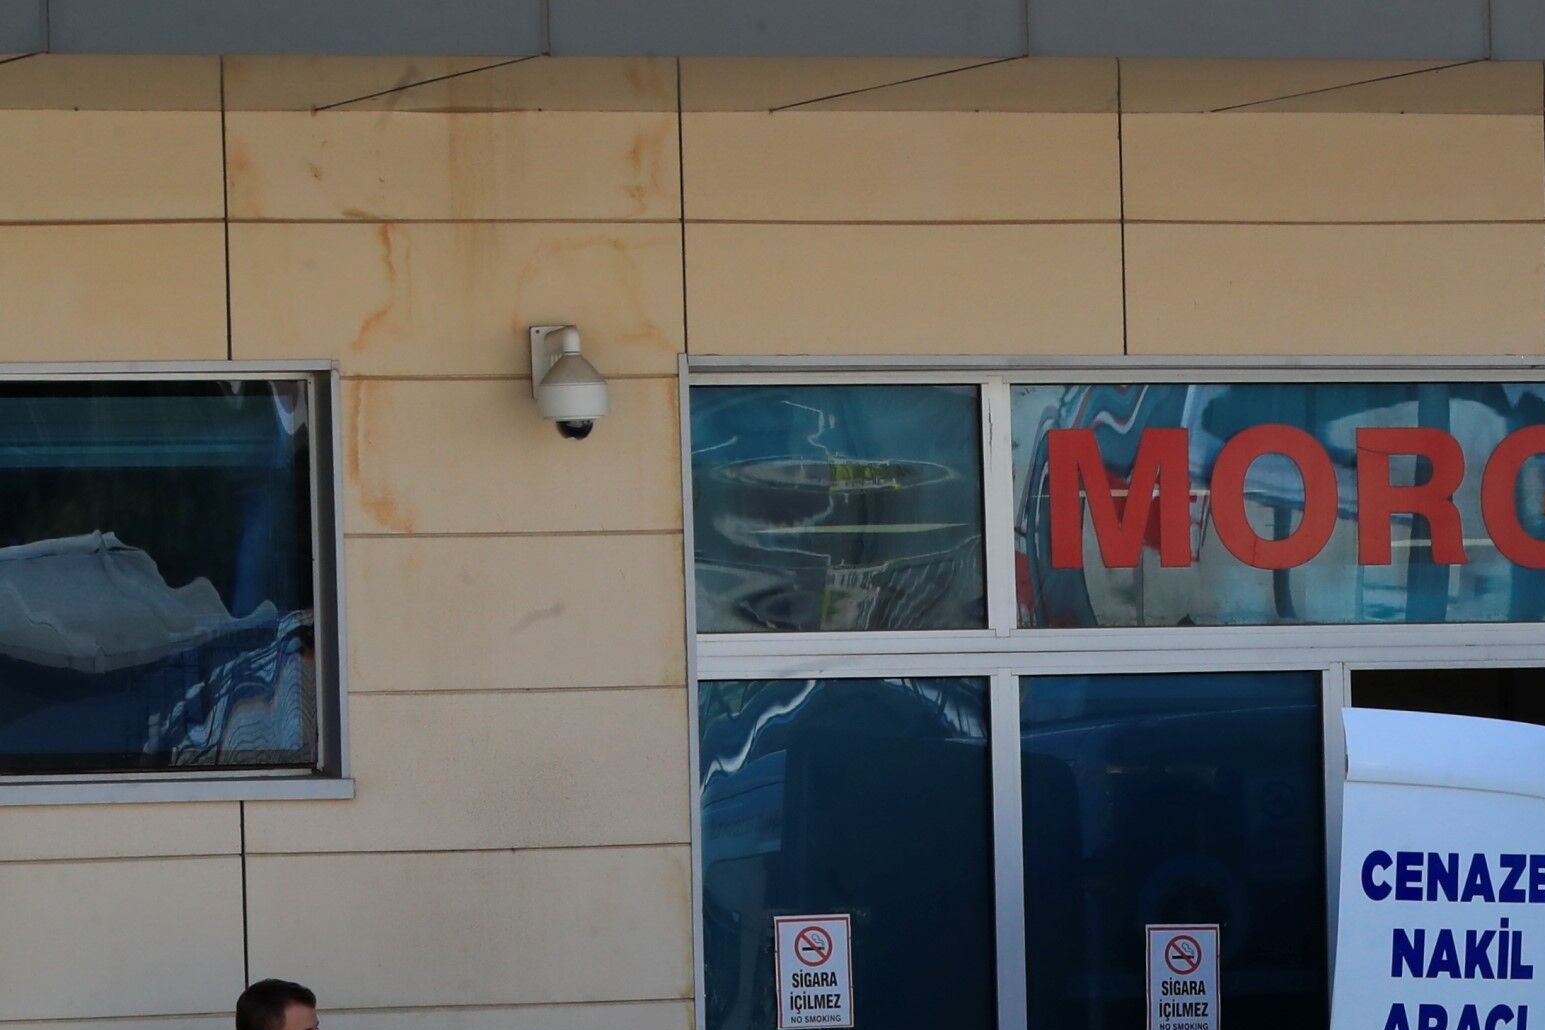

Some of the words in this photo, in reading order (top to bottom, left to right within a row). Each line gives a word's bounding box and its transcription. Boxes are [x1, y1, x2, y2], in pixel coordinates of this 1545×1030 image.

[1390, 917, 1534, 981] NAKİL
[792, 969, 838, 989] SİGARA
[1161, 977, 1206, 997] SİGARA
[790, 991, 842, 1015] İÇİLMEZ
[1159, 999, 1209, 1022] İÇİLMEZ
[791, 1016, 802, 1024] NO
[804, 1014, 842, 1024] SMOKING
[1160, 1023, 1171, 1030] NO
[1172, 1022, 1209, 1030] SMOKING
